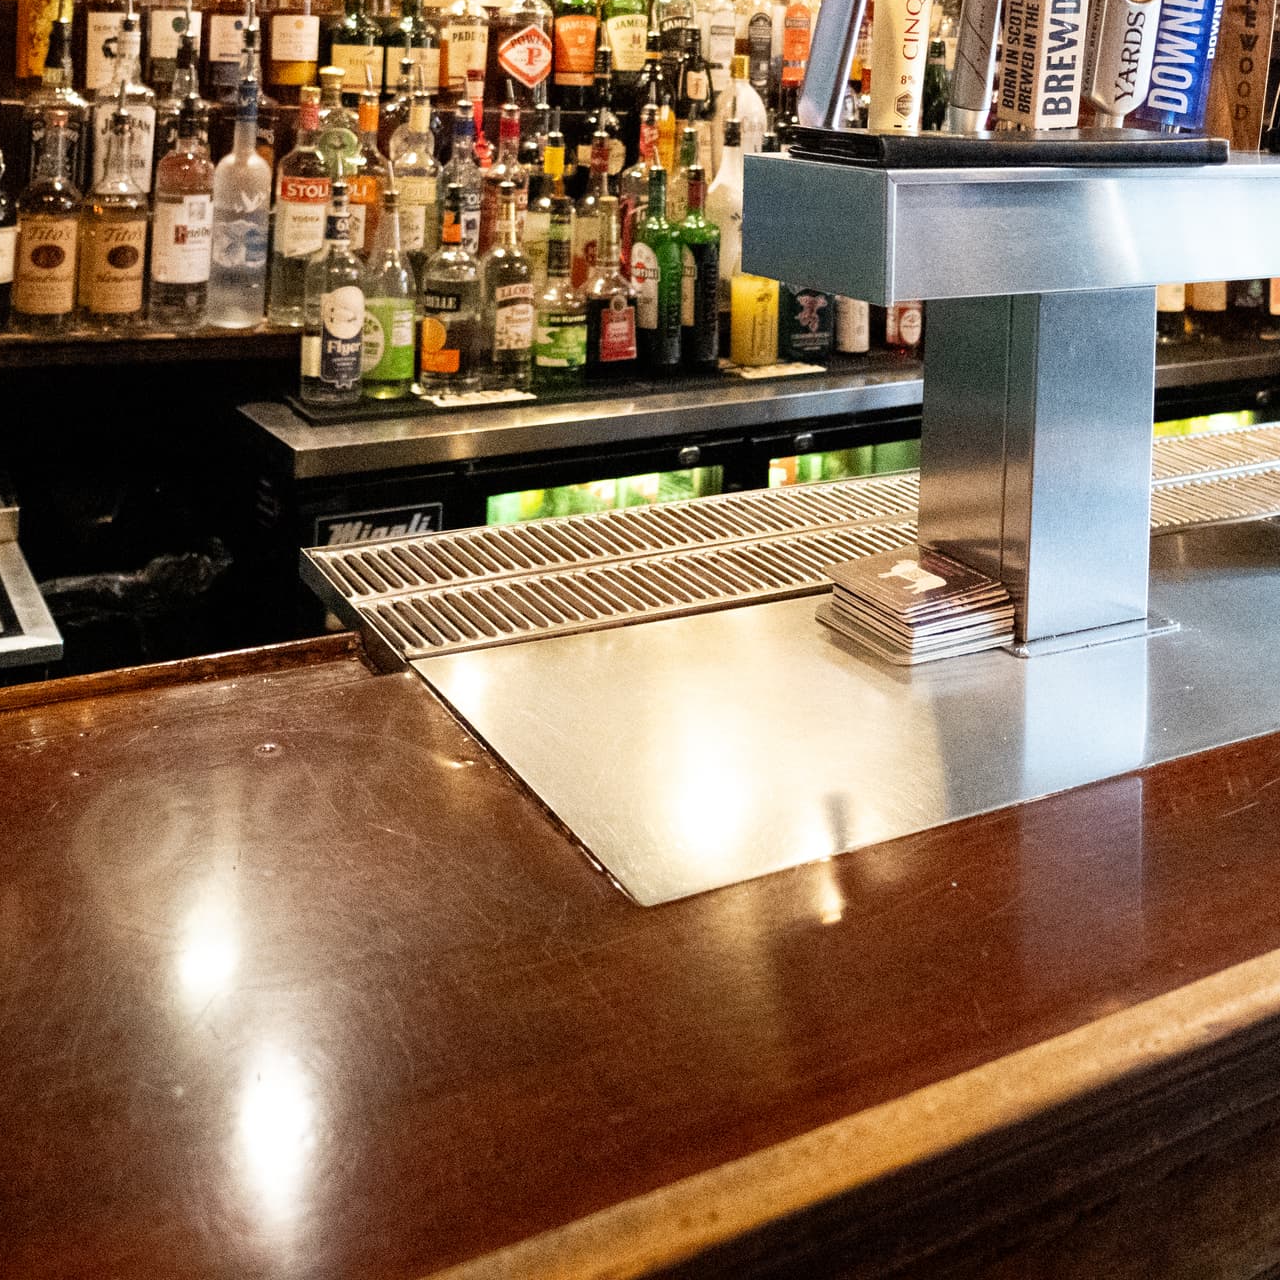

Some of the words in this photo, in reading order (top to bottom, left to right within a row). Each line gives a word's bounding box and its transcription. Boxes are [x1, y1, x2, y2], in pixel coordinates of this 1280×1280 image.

[1024, 3, 1040, 34] THE
[1022, 34, 1037, 51] IN
[524, 47, 543, 67] P
[1005, 48, 1019, 67] IN
[1114, 10, 1146, 104] YARDS
[1002, 72, 1019, 111] BORN
[1017, 54, 1036, 115] BREWED
[287, 183, 330, 198] STOLI
[27, 226, 71, 241] Tito's
[103, 227, 144, 242] Tito's
